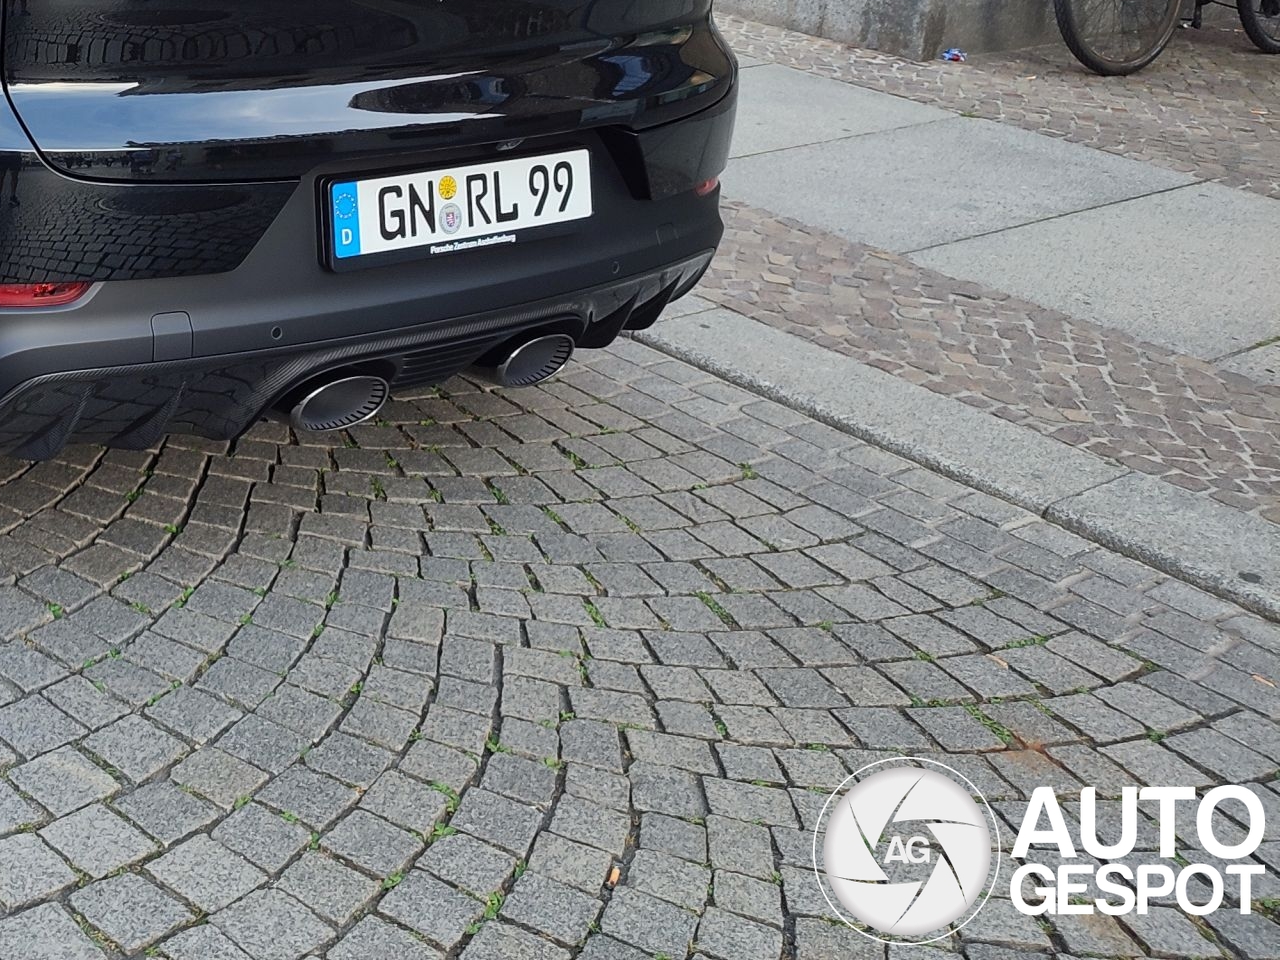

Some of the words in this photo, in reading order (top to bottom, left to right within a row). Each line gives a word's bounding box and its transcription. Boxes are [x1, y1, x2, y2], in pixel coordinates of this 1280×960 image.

[378, 180, 436, 241] GN
[466, 171, 519, 227] RL
[528, 161, 573, 217] 99
[341, 228, 353, 245] D
[430, 243, 454, 254] Porsche
